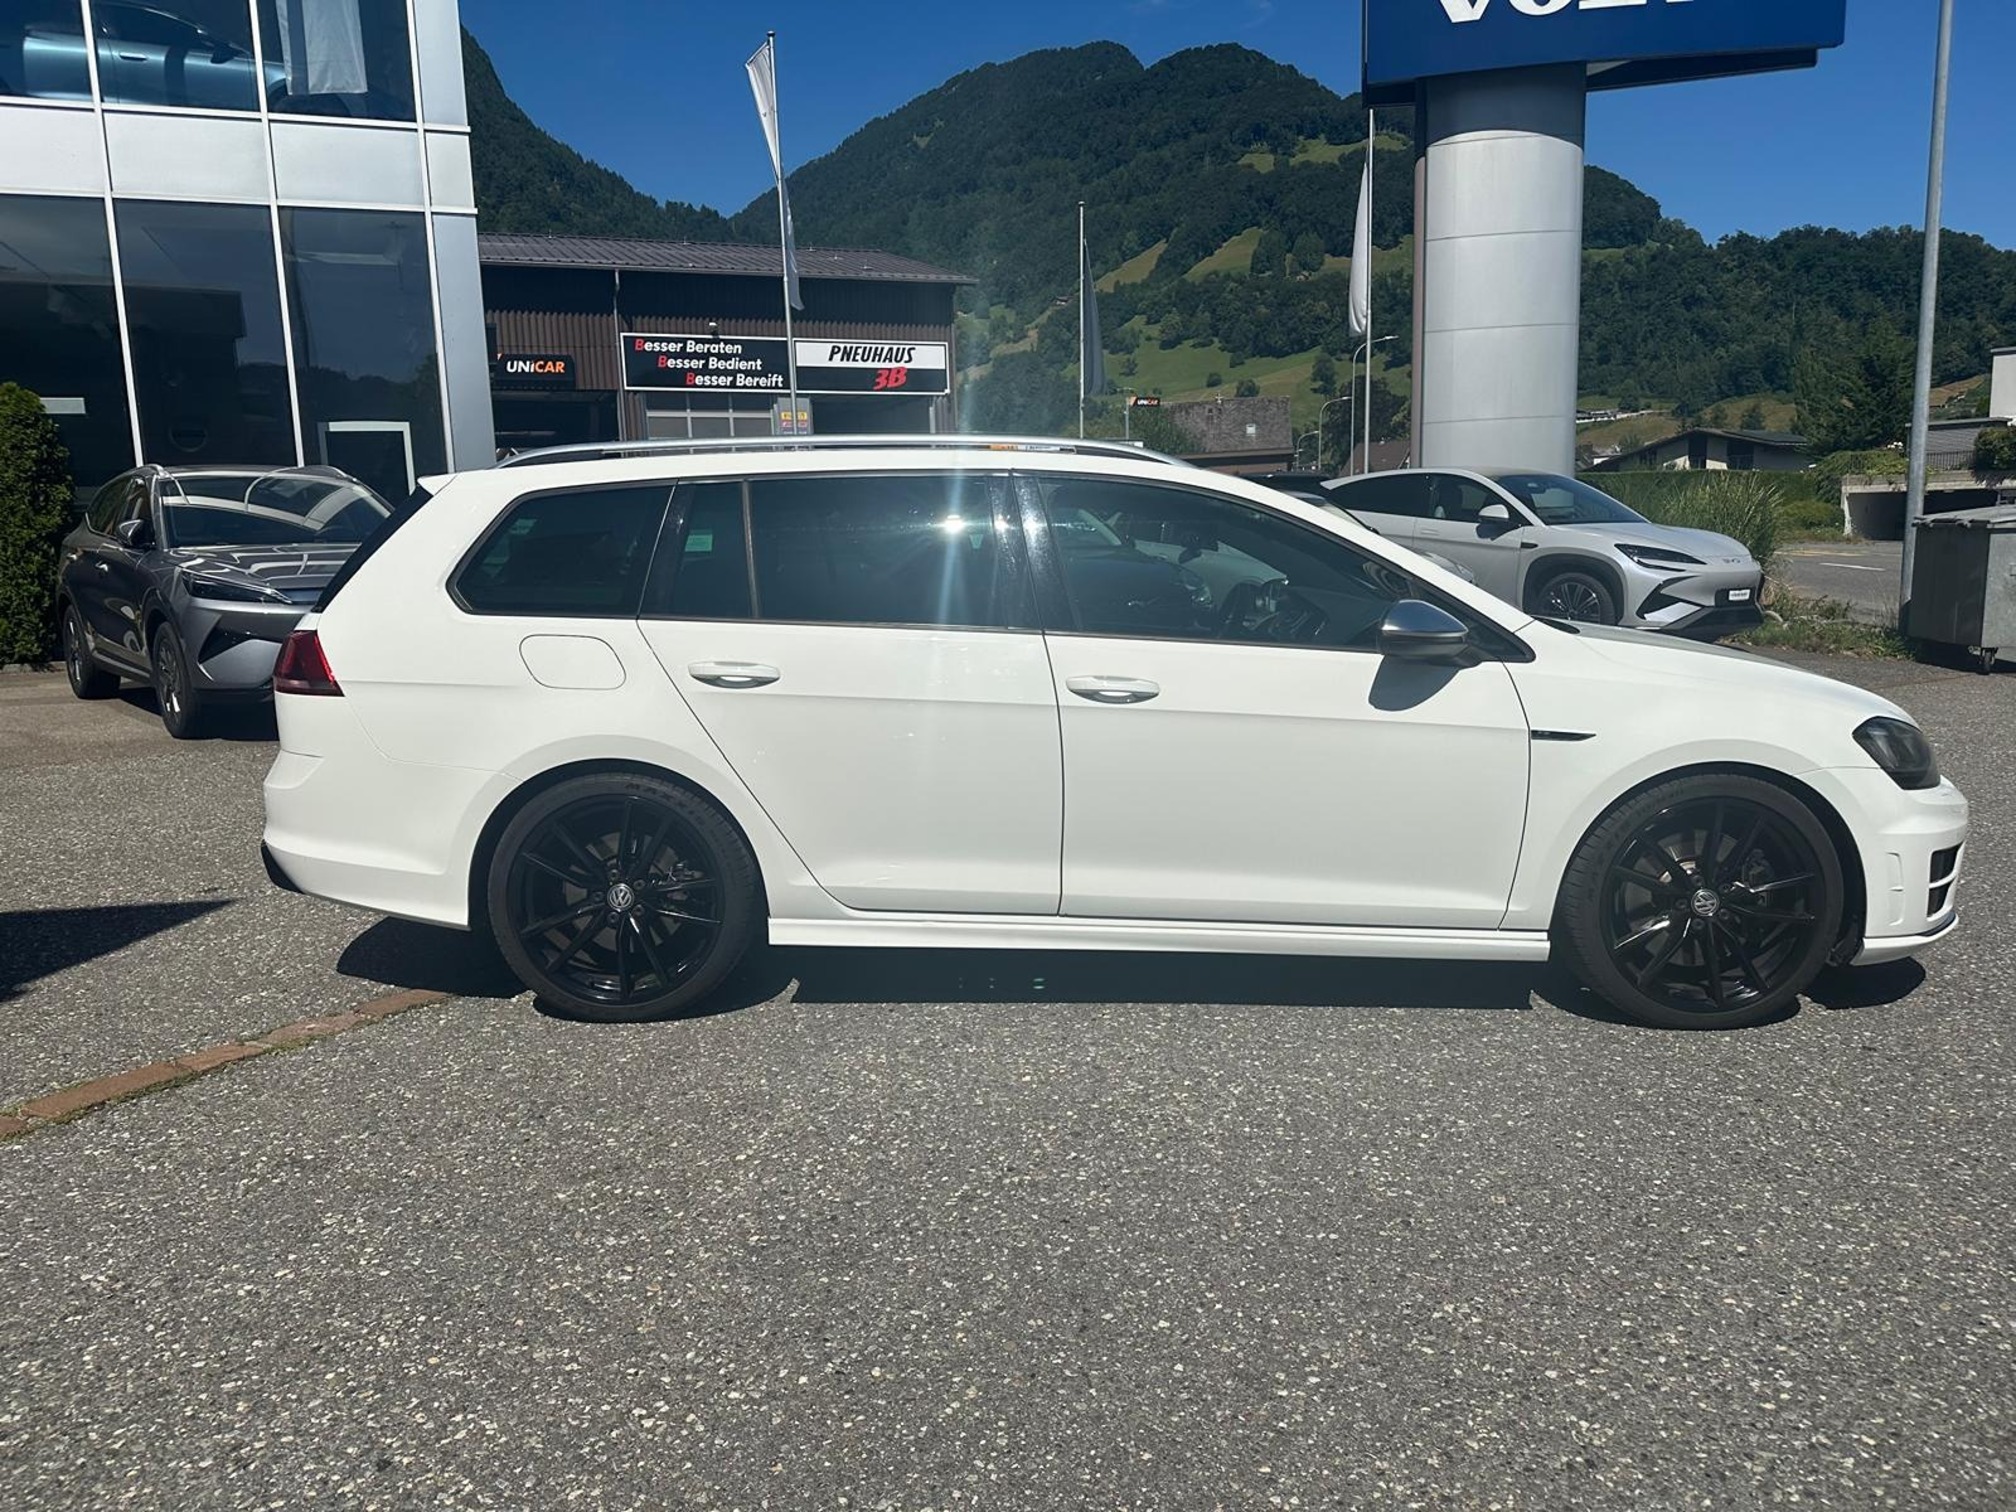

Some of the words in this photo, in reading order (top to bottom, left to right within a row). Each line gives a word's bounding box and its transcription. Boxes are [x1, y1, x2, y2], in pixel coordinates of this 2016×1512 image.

[634, 338, 683, 353] Besser
[686, 340, 742, 354] Beraten
[658, 355, 706, 369] Besser
[708, 357, 762, 370] Bedient
[828, 345, 916, 364] PNEUHAUS
[686, 372, 733, 386] Besser
[736, 374, 784, 387] Bereift
[873, 366, 908, 390] 3B
